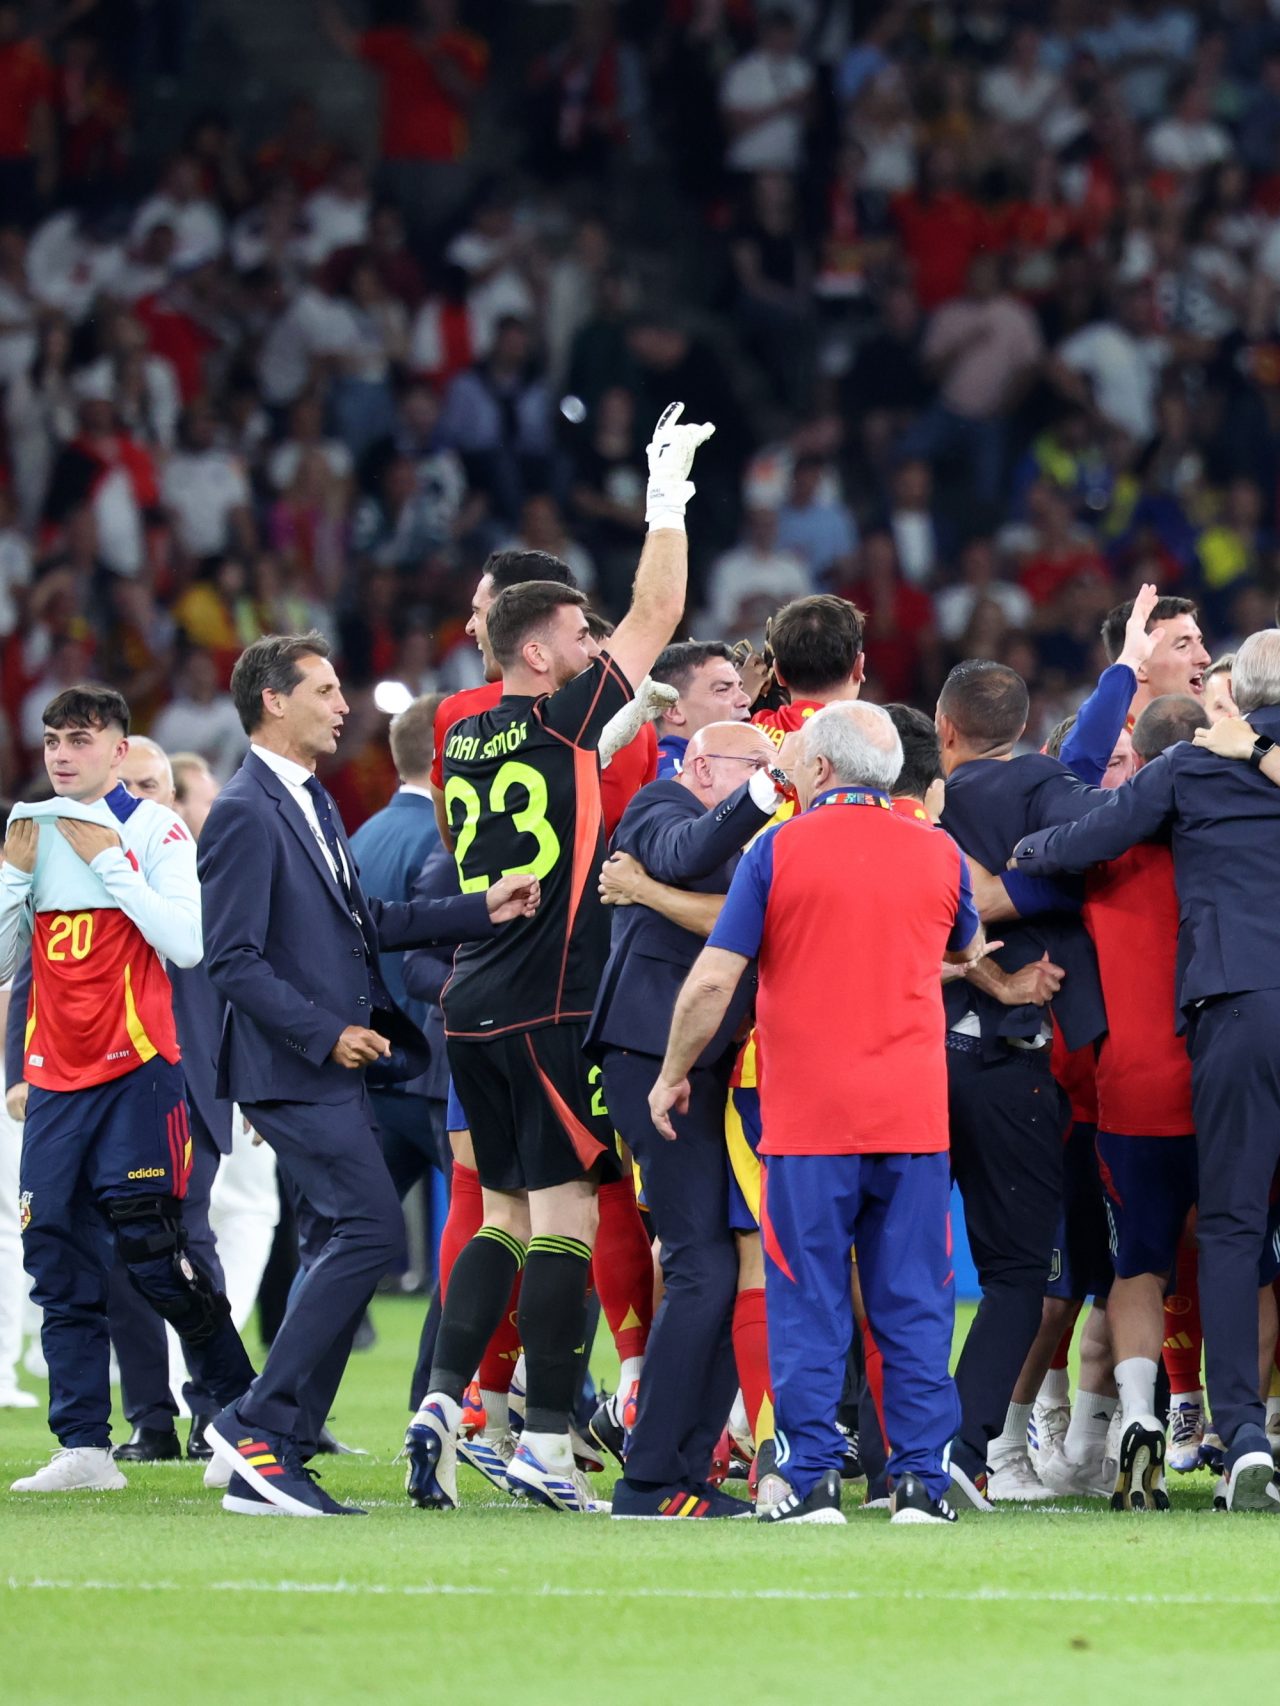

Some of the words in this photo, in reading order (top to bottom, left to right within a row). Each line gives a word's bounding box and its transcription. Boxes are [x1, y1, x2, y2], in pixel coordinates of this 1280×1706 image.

[480, 721, 528, 760] SMÓN
[445, 760, 561, 895] 23
[47, 912, 94, 961] 20
[127, 1167, 166, 1180] adidas
